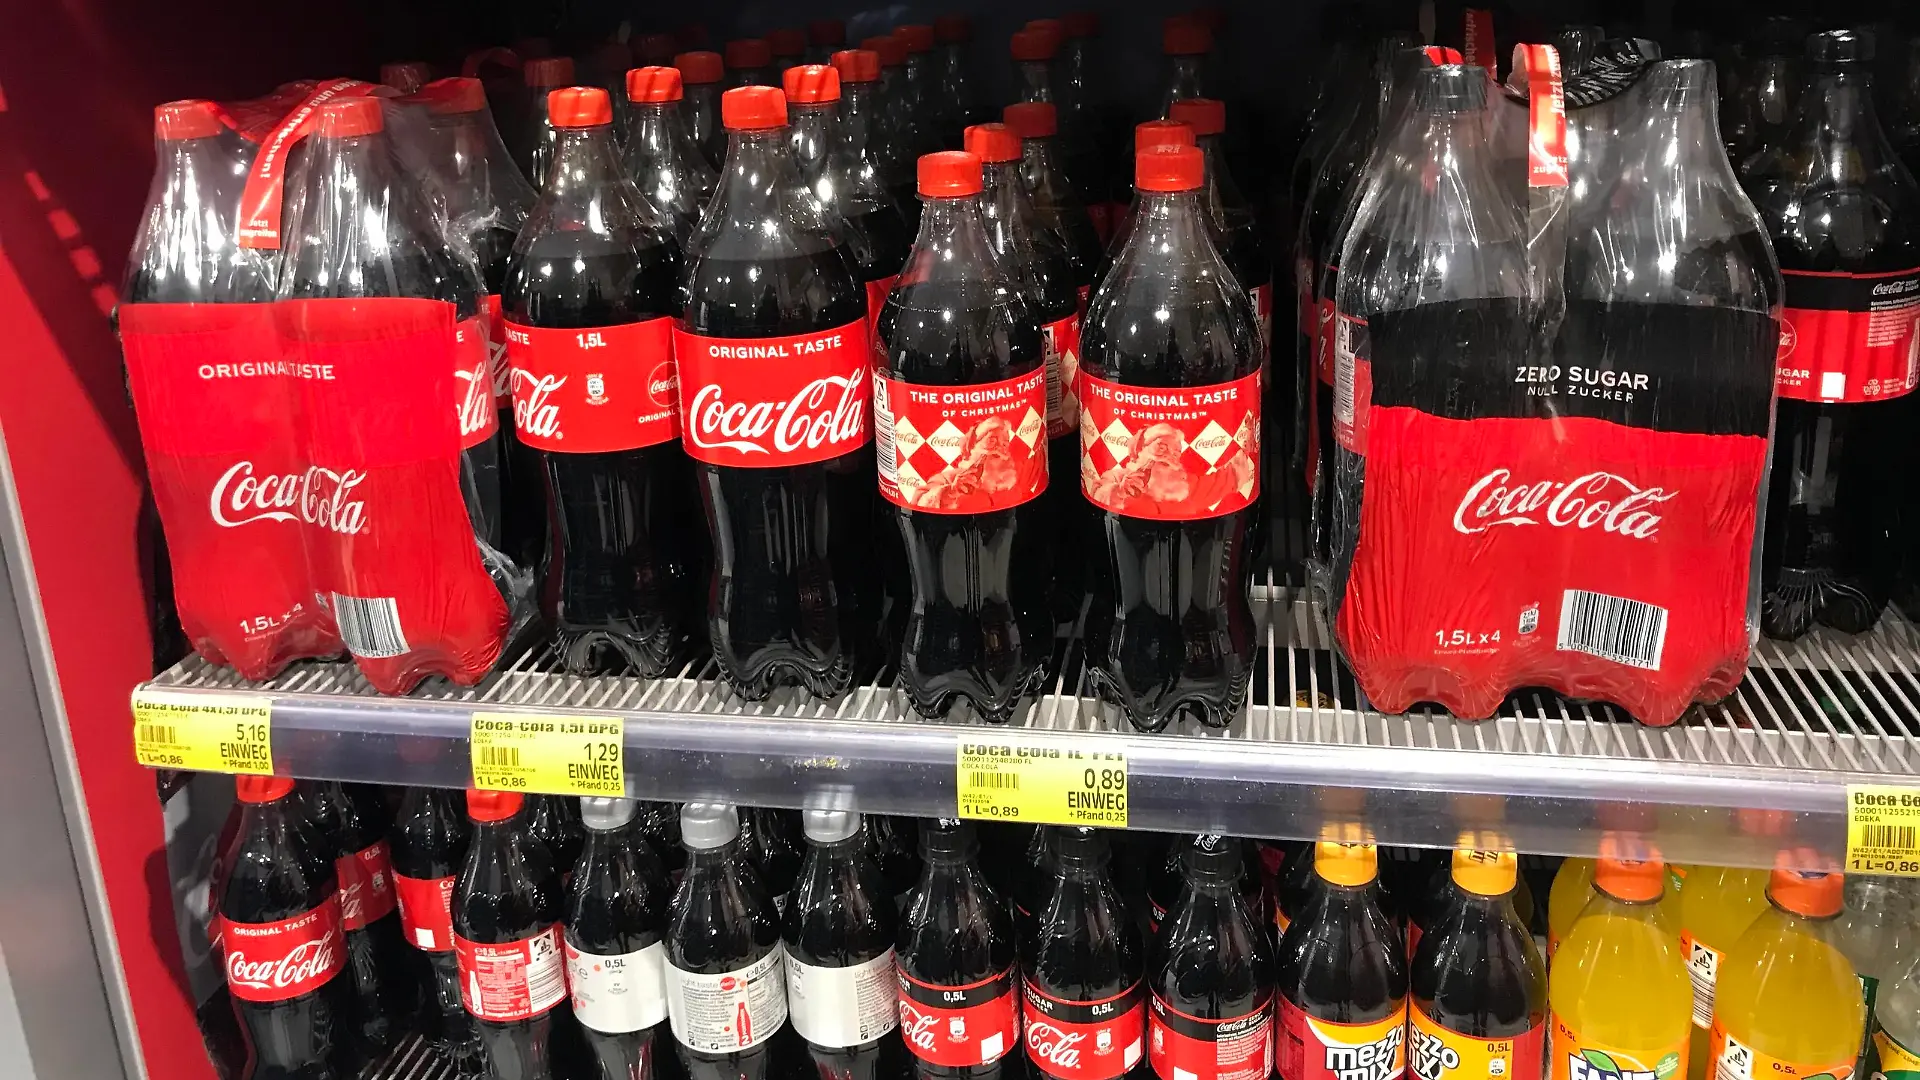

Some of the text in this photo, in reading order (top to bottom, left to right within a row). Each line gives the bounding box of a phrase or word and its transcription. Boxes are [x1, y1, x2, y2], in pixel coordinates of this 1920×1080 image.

[576, 333, 606, 350] 1,5L
[709, 335, 842, 359] ORIGINAL TASTE
[1514, 365, 1649, 391] ZERO SUGAR
[910, 374, 1044, 405] THE ORIGINAL TASTE
[1090, 384, 1238, 407] THE ORIGINAL TASTE
[1527, 385, 1634, 404] NULL ZUCKER
[638, 409, 675, 424] ORIGINAL
[690, 364, 867, 455] Coca-Cola
[942, 409, 956, 418] OF
[1114, 408, 1126, 416] OF
[210, 461, 368, 535] Coca-Cola
[1453, 469, 1680, 539] Coca-Cola
[1491, 629, 1501, 643] 4
[236, 724, 267, 743] 5,16
[475, 719, 554, 733] Coca-Cola
[588, 724, 619, 735] DPG
[139, 753, 145, 761] 1
[220, 742, 267, 760] EINWEG
[584, 743, 619, 764] 1,29
[963, 744, 1011, 756] Coca
[1017, 746, 1060, 759] Cola
[229, 760, 251, 769] Pfand
[253, 762, 269, 770] 1,00
[568, 763, 619, 781] EINWEG
[477, 776, 527, 788] 1 L=0,86
[577, 781, 601, 790] Pfand
[603, 782, 620, 791] 0,25
[1084, 768, 1125, 792] 0,89
[1068, 791, 1125, 811] EINWEG
[963, 804, 1019, 818] 1 L=0,89
[1077, 811, 1104, 821] Pfand
[1106, 812, 1126, 823] 0,25
[1851, 859, 1919, 873] 1 L=0,86
[233, 913, 318, 937] ORIGINAL TASTE
[228, 928, 334, 989] Coca-Cola
[604, 959, 627, 969] 0,5L
[943, 990, 967, 1002] 0,5L
[1027, 987, 1053, 1010] SUGAR
[1092, 1002, 1114, 1016] 0,5L
[1559, 1023, 1577, 1043] 0,5L
[1325, 1024, 1405, 1070] mezzo
[1487, 1042, 1511, 1053] 0,5L
[1772, 1062, 1797, 1075] 0,5L
